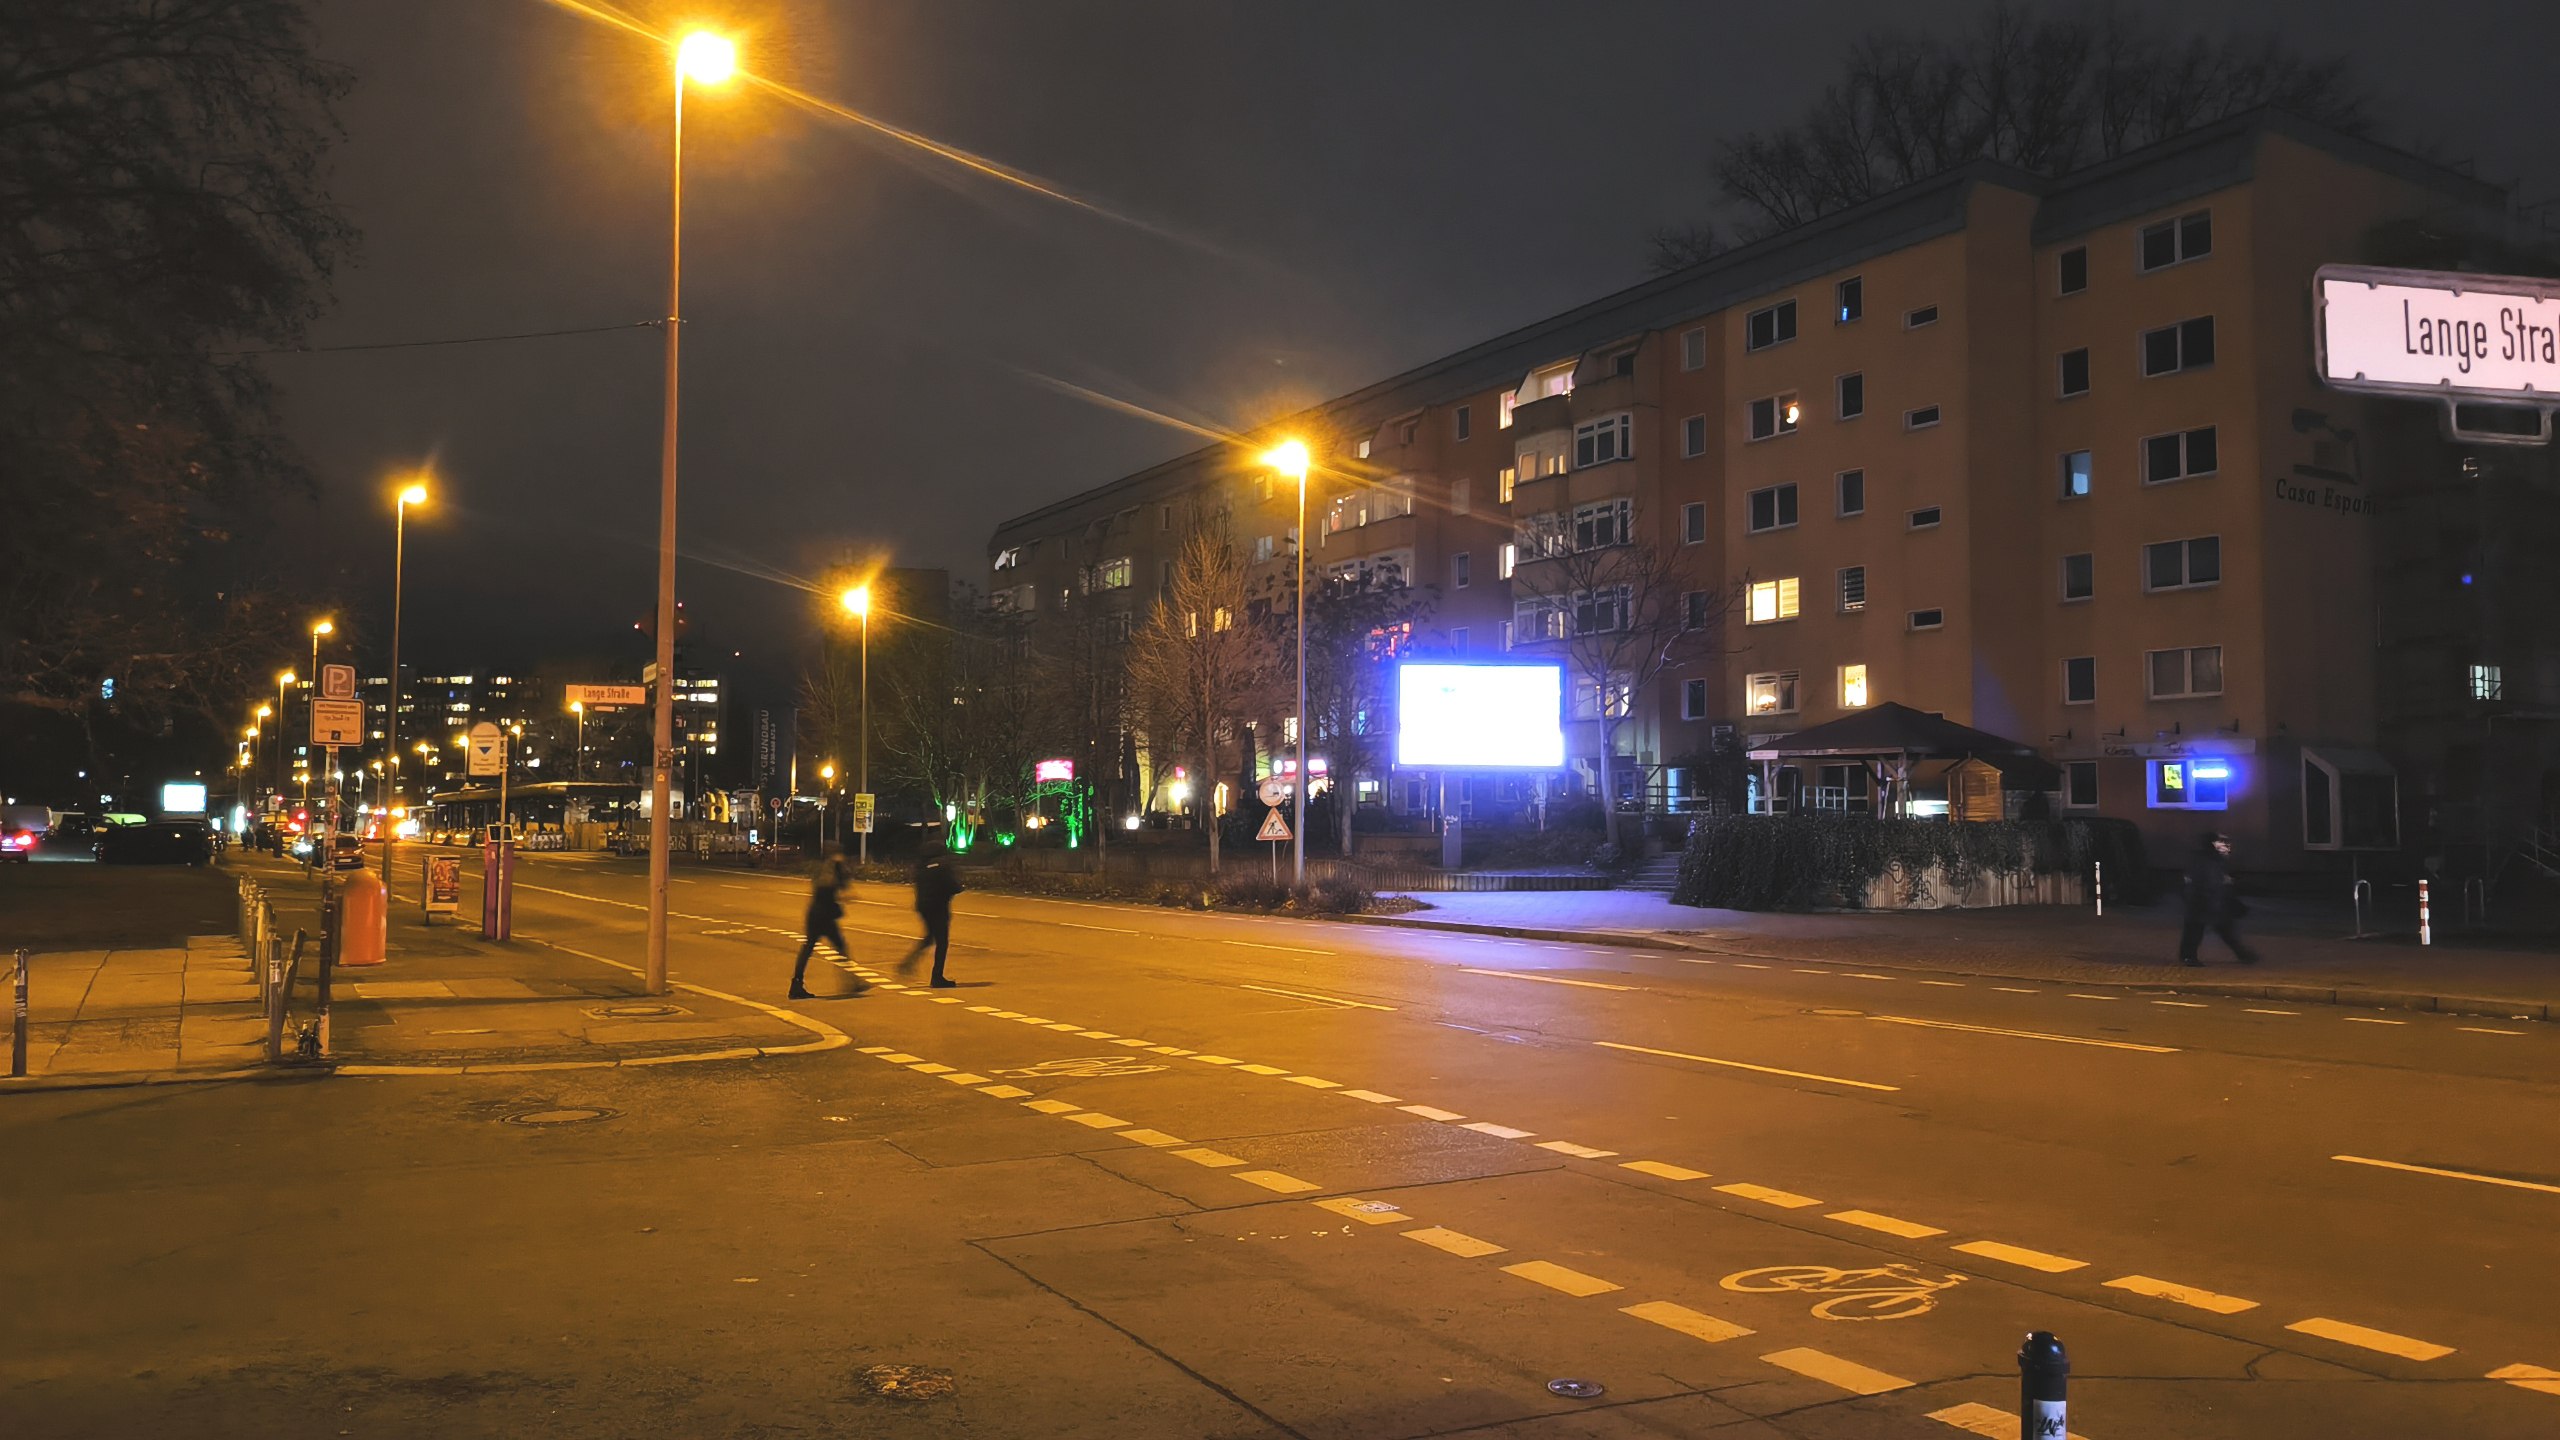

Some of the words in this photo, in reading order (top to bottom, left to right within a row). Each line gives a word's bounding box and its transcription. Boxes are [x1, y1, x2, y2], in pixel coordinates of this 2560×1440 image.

[2403, 298, 2488, 374] Lange
[2500, 307, 2560, 364] Stra
[2275, 478, 2316, 505] Casa
[329, 668, 346, 692] P
[584, 688, 605, 700] Lange
[607, 689, 629, 699] Straße
[760, 710, 769, 768] GRUNDBAU
